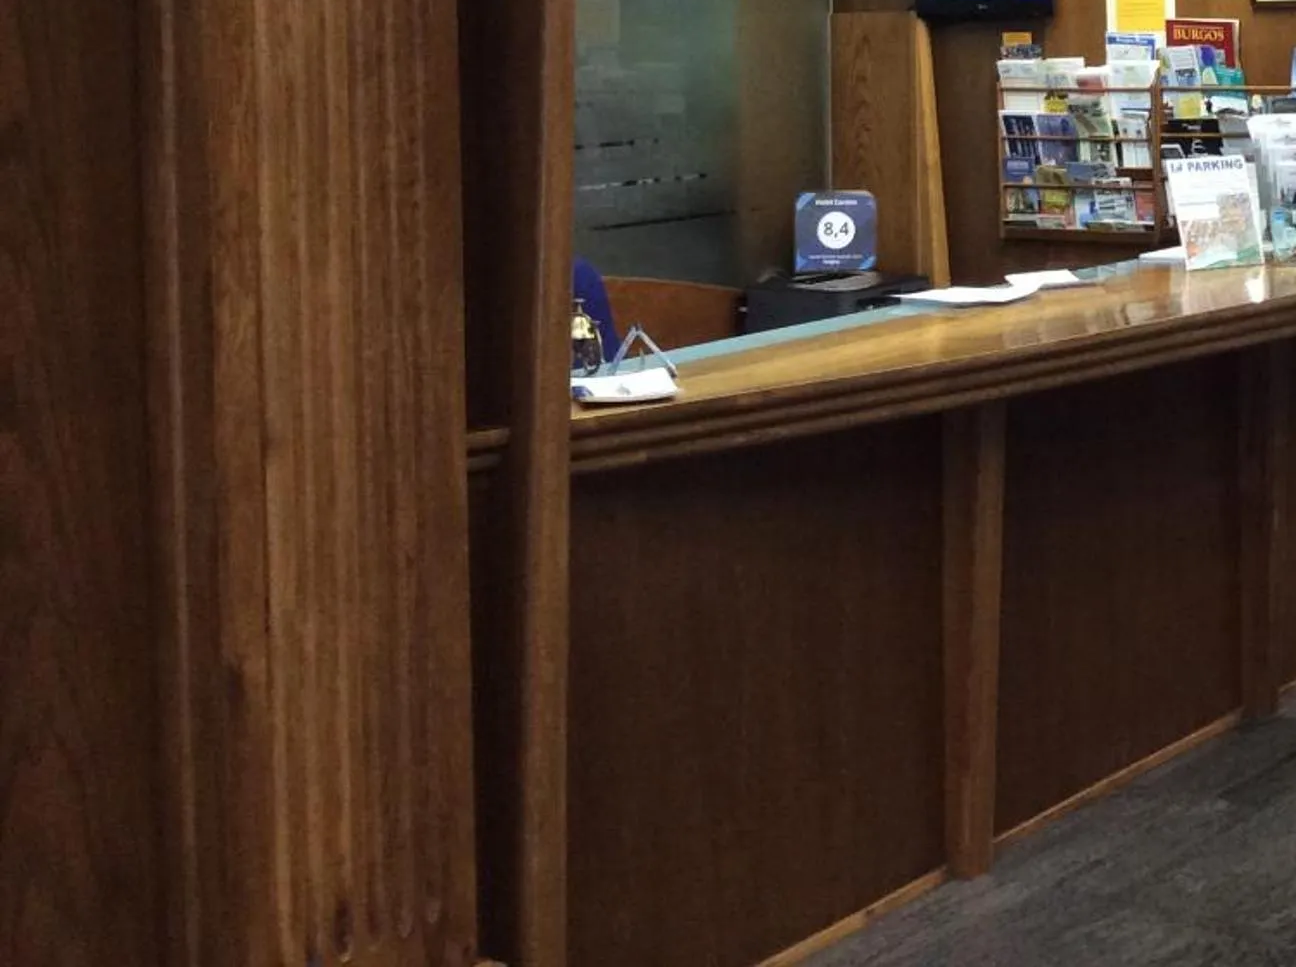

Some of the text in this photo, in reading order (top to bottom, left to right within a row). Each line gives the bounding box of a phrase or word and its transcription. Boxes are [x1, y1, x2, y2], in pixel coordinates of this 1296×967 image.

[1172, 27, 1225, 42] BURGOS
[1187, 158, 1244, 172] PARKING
[823, 221, 849, 239] 8,4
